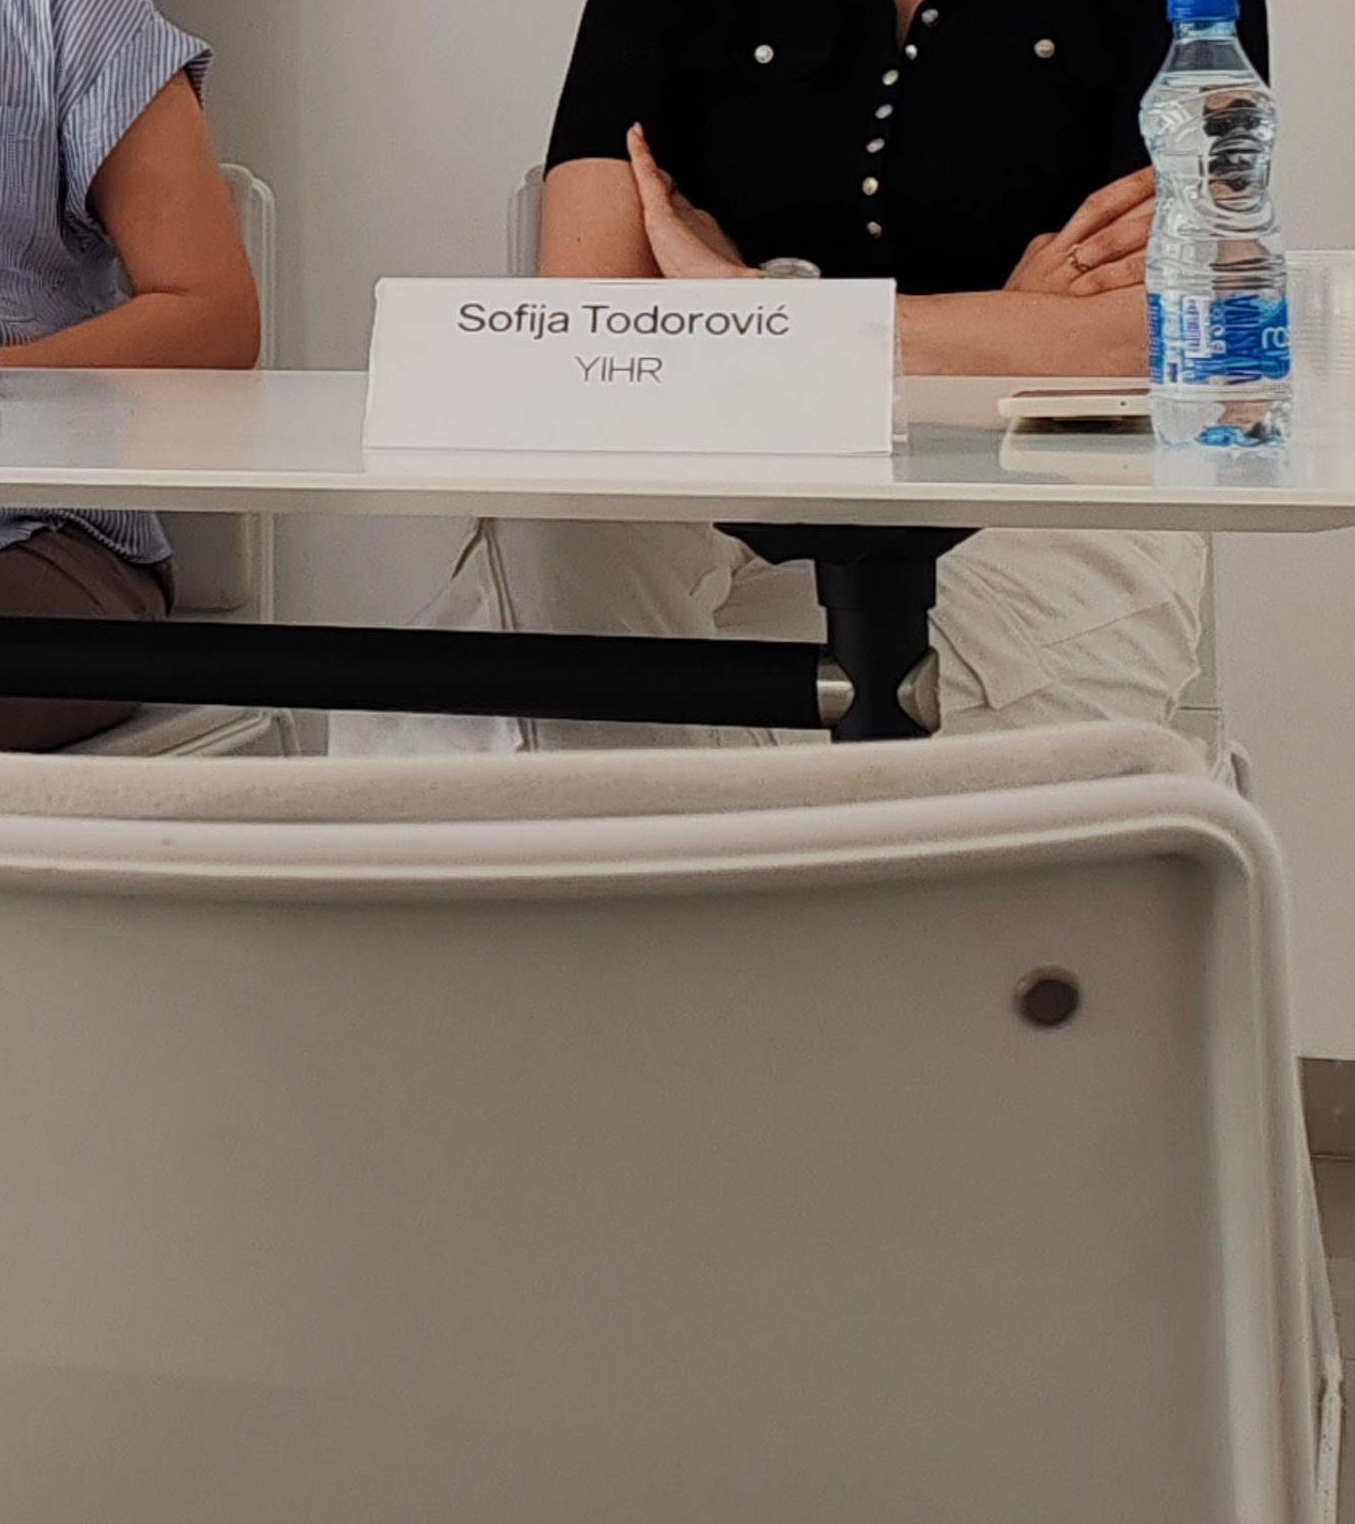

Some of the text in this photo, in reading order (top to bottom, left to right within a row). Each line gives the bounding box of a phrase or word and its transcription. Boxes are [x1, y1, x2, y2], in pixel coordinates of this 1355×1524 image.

[457, 303, 791, 340] Sofija Todorović
[576, 356, 664, 383] YIHR
